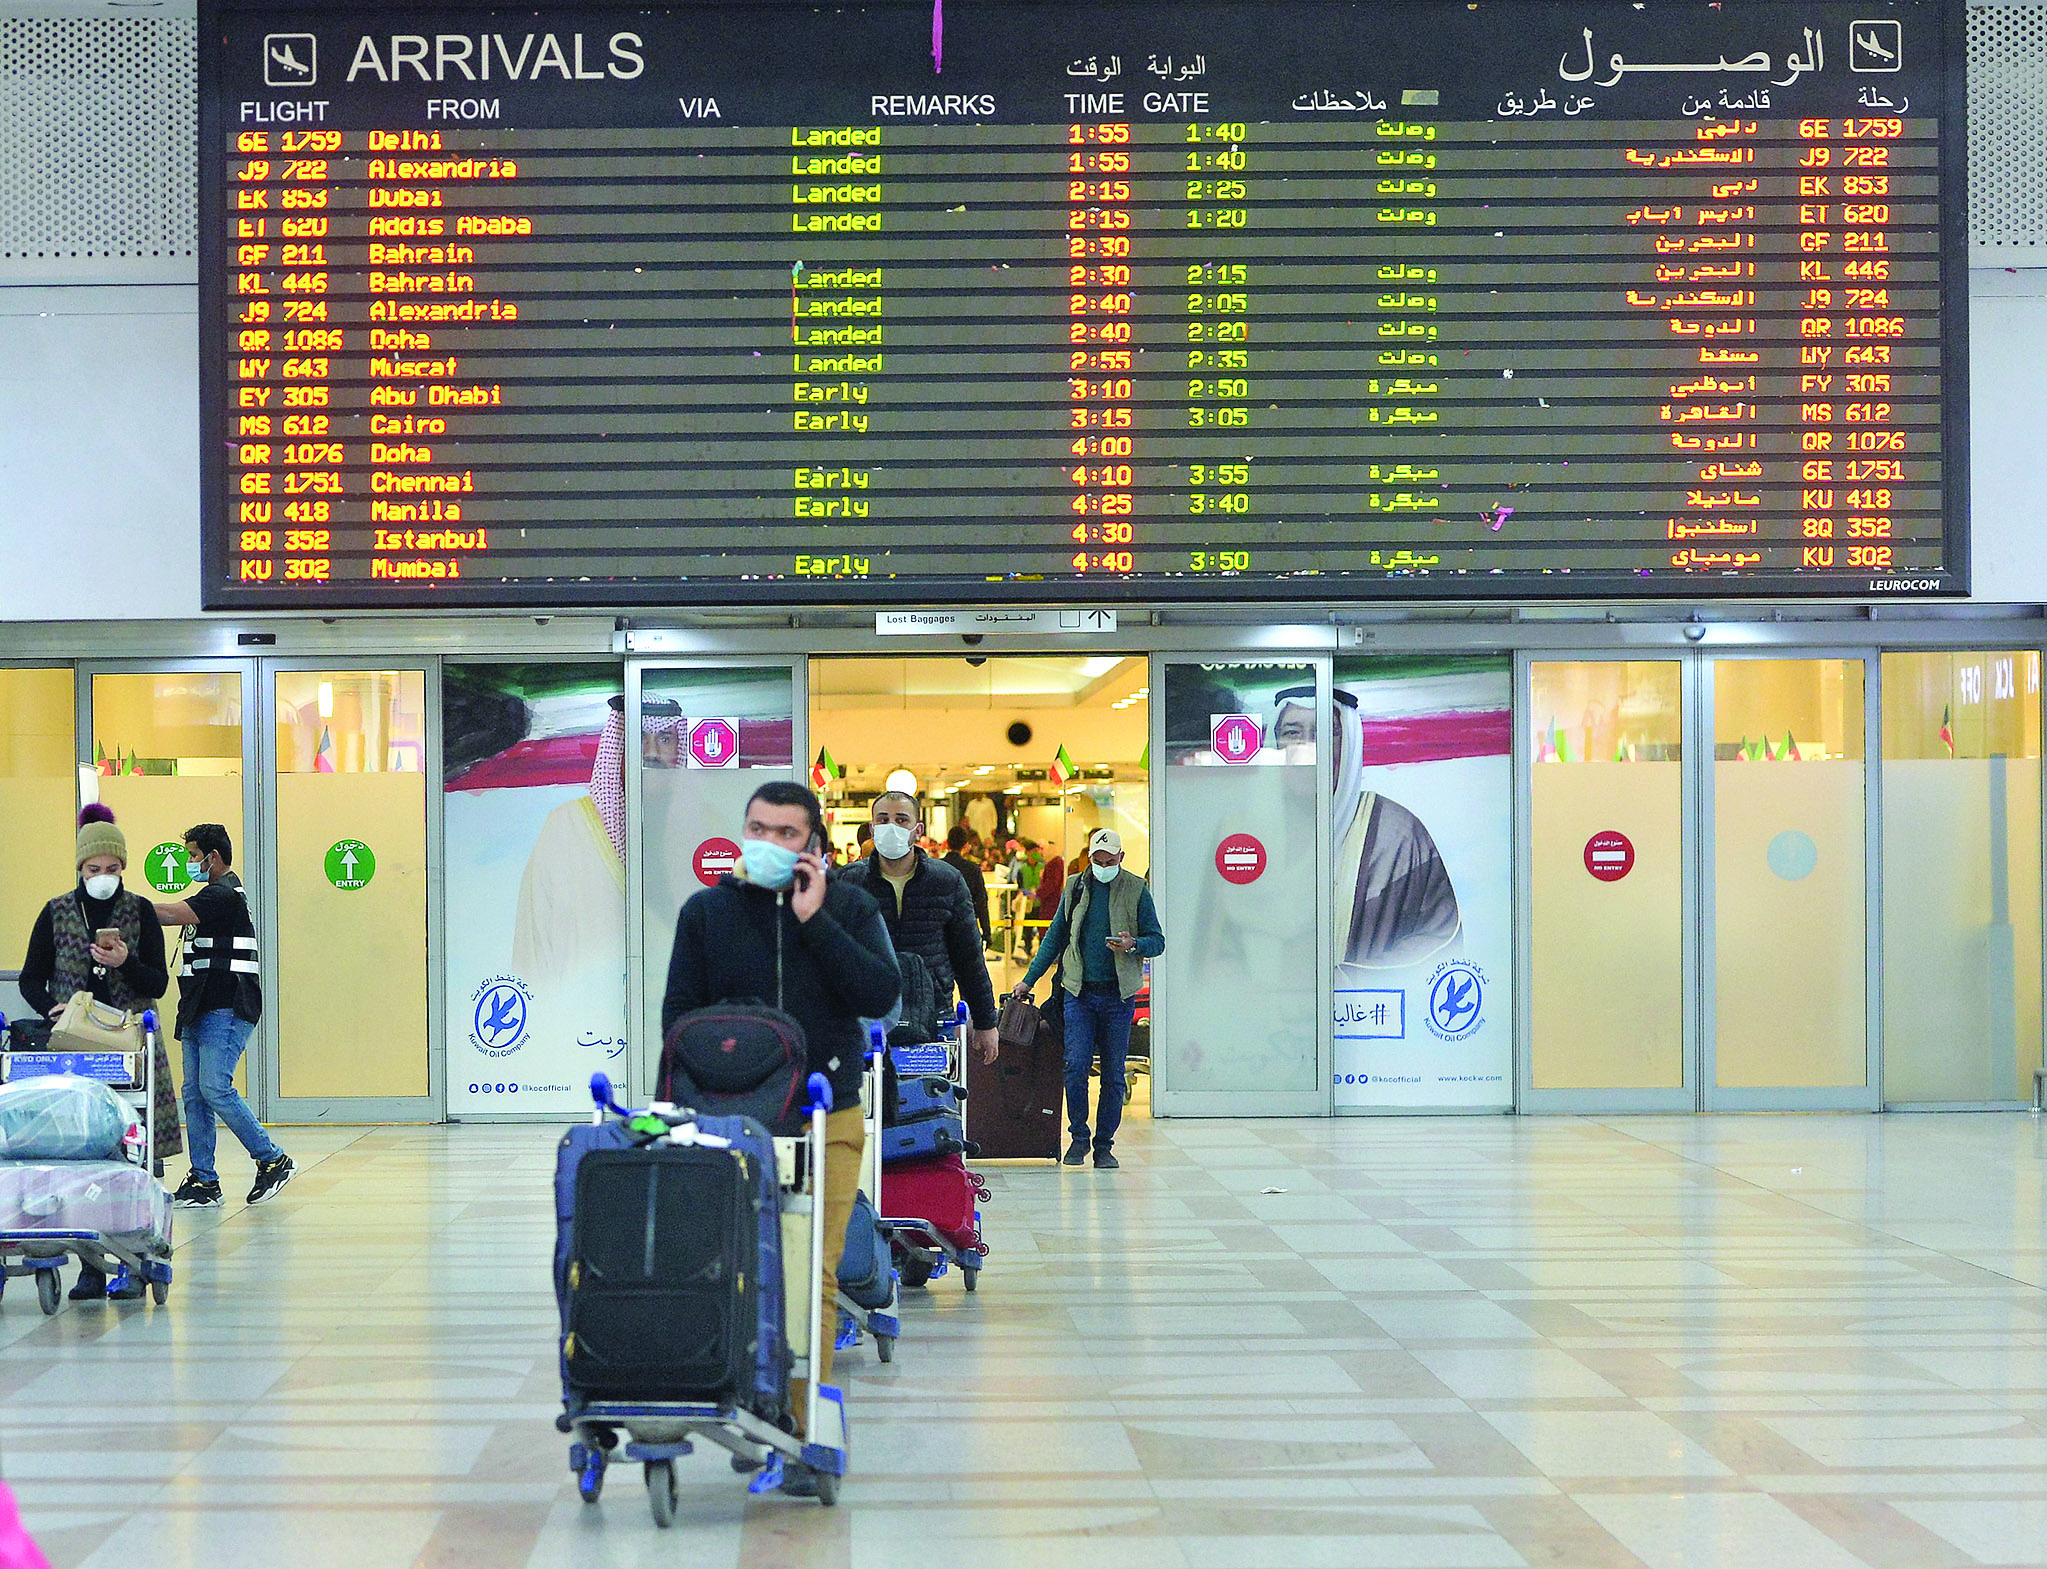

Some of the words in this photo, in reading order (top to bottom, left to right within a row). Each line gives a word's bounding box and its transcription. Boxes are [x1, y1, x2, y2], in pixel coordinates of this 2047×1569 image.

[347, 33, 644, 81] ARRIVALS
[1067, 55, 1121, 82] الوقت
[1147, 54, 1206, 82] البوابة
[679, 98, 721, 118] VIA
[871, 95, 996, 116] REMARKS
[1064, 94, 1124, 113] TIME
[1143, 93, 1209, 113] GATE
[1291, 89, 1387, 112] ملاحظات
[1497, 88, 1557, 116] طريق
[1563, 93, 1596, 115] عن
[1681, 96, 1712, 117] من
[1719, 88, 1771, 109] قادمة
[1857, 86, 1909, 114] رحلة
[240, 100, 330, 122] FLIGHT
[427, 99, 500, 120] FROM
[792, 127, 880, 145] Landed
[1069, 124, 1130, 144] 1:55
[1187, 123, 1245, 141] 1:40
[1378, 122, 1435, 140] وصلت
[1799, 119, 1830, 139] 6E
[1843, 119, 1903, 138] 1759
[237, 132, 270, 153] 6E
[281, 131, 342, 152] 1759
[368, 130, 443, 151] Delhi
[368, 156, 517, 179] Alexandria
[792, 155, 880, 174] Landed
[1069, 152, 1129, 173] 1:55
[1187, 152, 1245, 170] 1:40
[1799, 148, 1831, 167] J9
[1843, 147, 1889, 167] 722
[793, 184, 881, 203] Landed
[1069, 181, 1130, 201] 2:15
[1187, 181, 1245, 199] 2:25
[1799, 176, 1830, 196] EK
[1843, 176, 1889, 196] 853
[369, 216, 445, 236] Addis
[456, 216, 532, 235] Ababa
[793, 213, 881, 231] Landed
[1069, 210, 1130, 230] 2:15
[1187, 210, 1246, 227] 1:20
[369, 243, 474, 265] Bahrain
[1069, 236, 1131, 258] 2:30
[369, 271, 474, 293] Bahrain
[793, 268, 881, 288] Landed
[1070, 265, 1130, 286] 2:30
[1188, 265, 1247, 284] 2:15
[370, 299, 518, 321] Alexandria
[794, 297, 882, 316] Landed
[1070, 294, 1131, 315] 2:40
[1188, 294, 1247, 313] 2:05
[370, 328, 431, 350] Doha
[794, 325, 882, 345] Landed
[1070, 323, 1131, 344] 2:40
[370, 357, 458, 378] Muscat
[794, 354, 882, 372] Landed
[239, 387, 272, 407] EY
[283, 386, 329, 407] 305
[370, 388, 415, 406] Abu
[428, 385, 501, 406] Dhabi
[794, 382, 867, 404] Early
[1070, 379, 1131, 399] 3:10
[1189, 379, 1247, 397] 2:50
[1369, 379, 1437, 395] مبكرة
[239, 415, 272, 437] MS
[283, 415, 330, 436] 612
[370, 414, 446, 435] Cairo
[794, 411, 867, 432] Early
[1071, 408, 1132, 428] 3:15
[1189, 408, 1249, 426] 3:05
[240, 444, 272, 465] QR
[283, 443, 344, 464] 1076
[371, 442, 432, 464] Doha
[1071, 437, 1133, 457] 4:00
[795, 468, 868, 488] Early
[1071, 465, 1133, 487] 4:10
[1190, 465, 1250, 484] 3:55
[1802, 460, 1833, 481] 6E
[1846, 460, 1904, 481] 1751
[240, 473, 272, 495] 6E
[283, 472, 344, 494] 1751
[371, 471, 474, 493] Chennai
[795, 497, 868, 517] Early
[1072, 494, 1132, 515] 4:25
[1190, 494, 1248, 513] 3:40
[1802, 489, 1833, 510] KU
[1846, 489, 1891, 510] 418
[240, 501, 273, 523] KU
[284, 501, 330, 523] 418
[371, 500, 461, 522] Manila
[240, 530, 273, 551] 8Q
[284, 529, 331, 551] 352
[374, 528, 488, 550] Istanbul
[1072, 522, 1133, 544] 4:30
[796, 555, 869, 577] Early
[1072, 551, 1134, 572] 4:40
[1190, 551, 1249, 570] 3:50
[1802, 546, 1833, 567] KU
[1847, 546, 1892, 567] 302
[241, 559, 273, 582] KU
[284, 559, 331, 582] 302
[371, 558, 460, 579] Mumbai
[1869, 577, 1941, 592] LEUROCOM
[887, 615, 907, 623] Lost
[910, 614, 955, 625] Baggages
[155, 843, 185, 855] دخول
[336, 841, 364, 852] دخول
[470, 978, 493, 1002] الكويت
[516, 978, 535, 1001] شركة
[1333, 1003, 1391, 1027] #غالي
[1423, 1017, 1444, 1040] Kuwait
[1444, 1034, 1456, 1042] Oil
[1456, 1016, 1486, 1041] Company
[468, 1032, 489, 1056] Kuwait
[489, 1049, 500, 1058] Oil
[500, 1032, 531, 1058] Company
[576, 1031, 627, 1060] ويت
[35, 1055, 58, 1063] ONLY
[1371, 1076, 1422, 1084] @kocofficial
[1438, 1074, 1503, 1083] www.kockw.com
